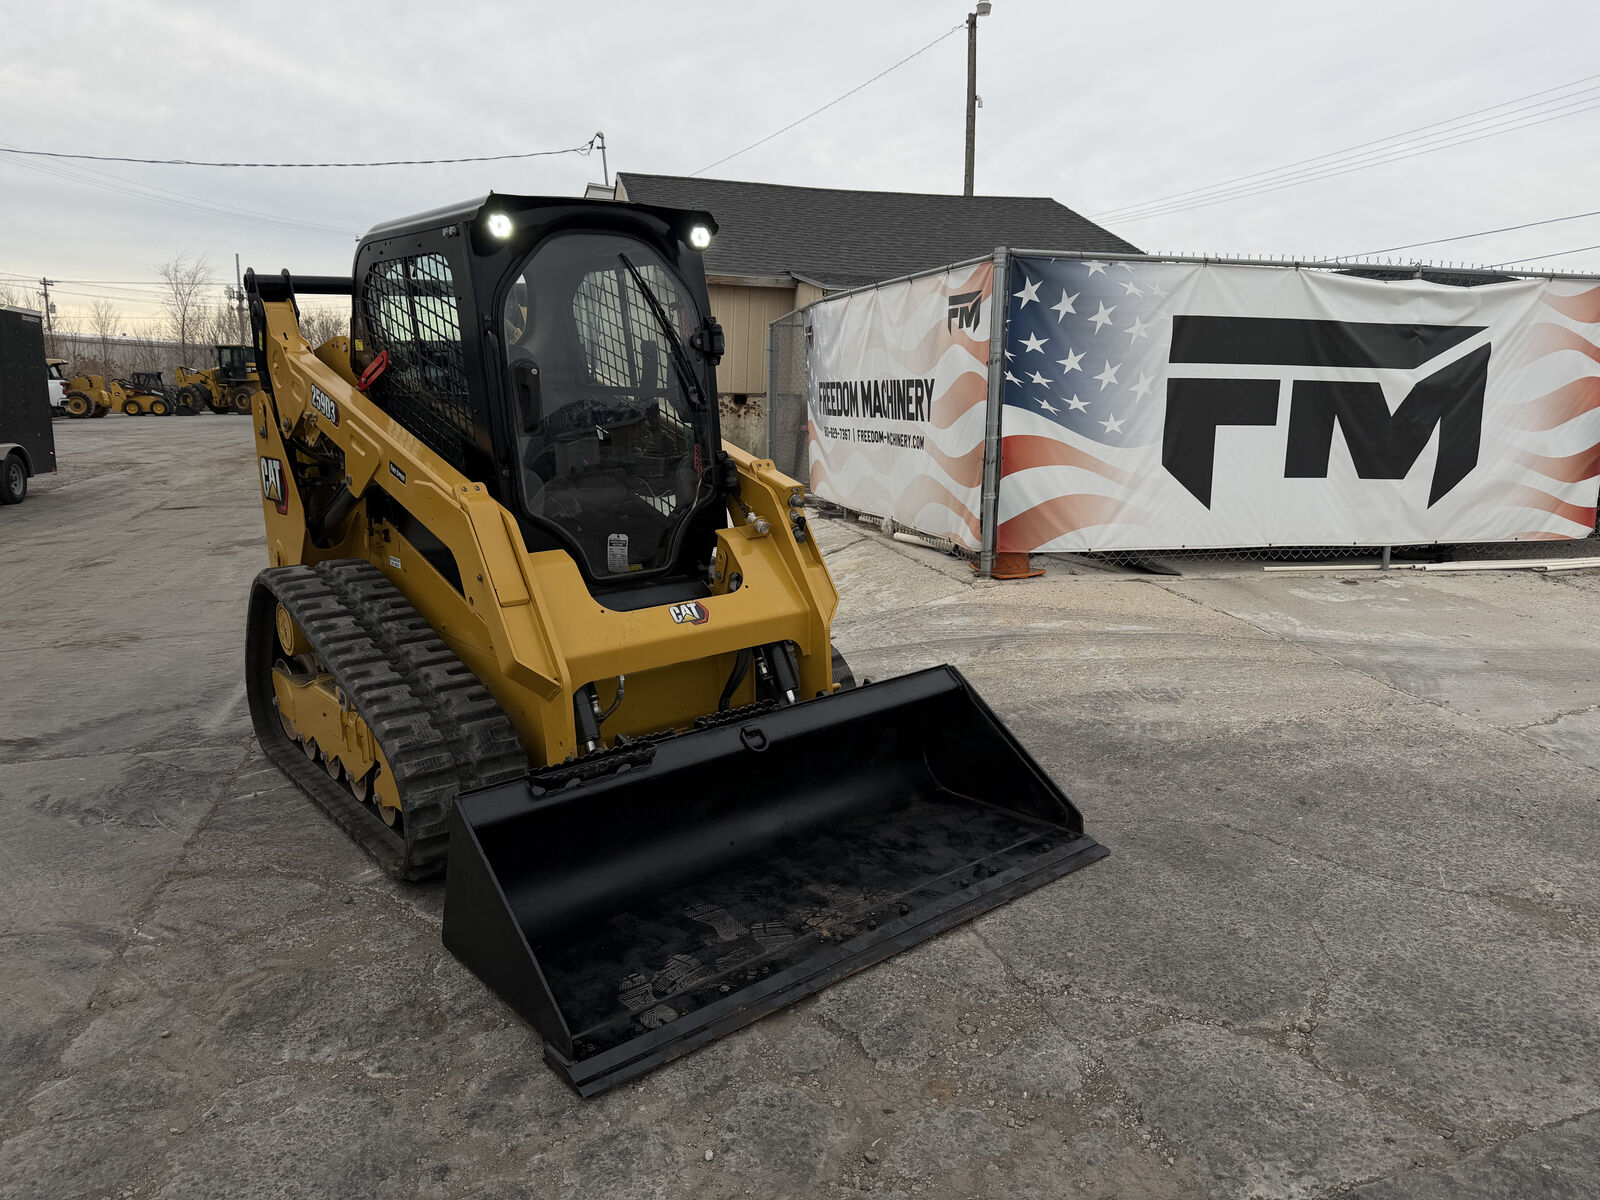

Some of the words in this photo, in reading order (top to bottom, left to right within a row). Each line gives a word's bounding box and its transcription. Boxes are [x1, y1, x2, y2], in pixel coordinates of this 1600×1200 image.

[948, 290, 983, 335] FM
[311, 384, 336, 424] 259D3
[818, 381, 859, 418] FREEDOM
[860, 378, 936, 423] MACHINERY
[1162, 314, 1492, 511] FM
[260, 457, 282, 502] CAT
[669, 602, 700, 624] CAT
